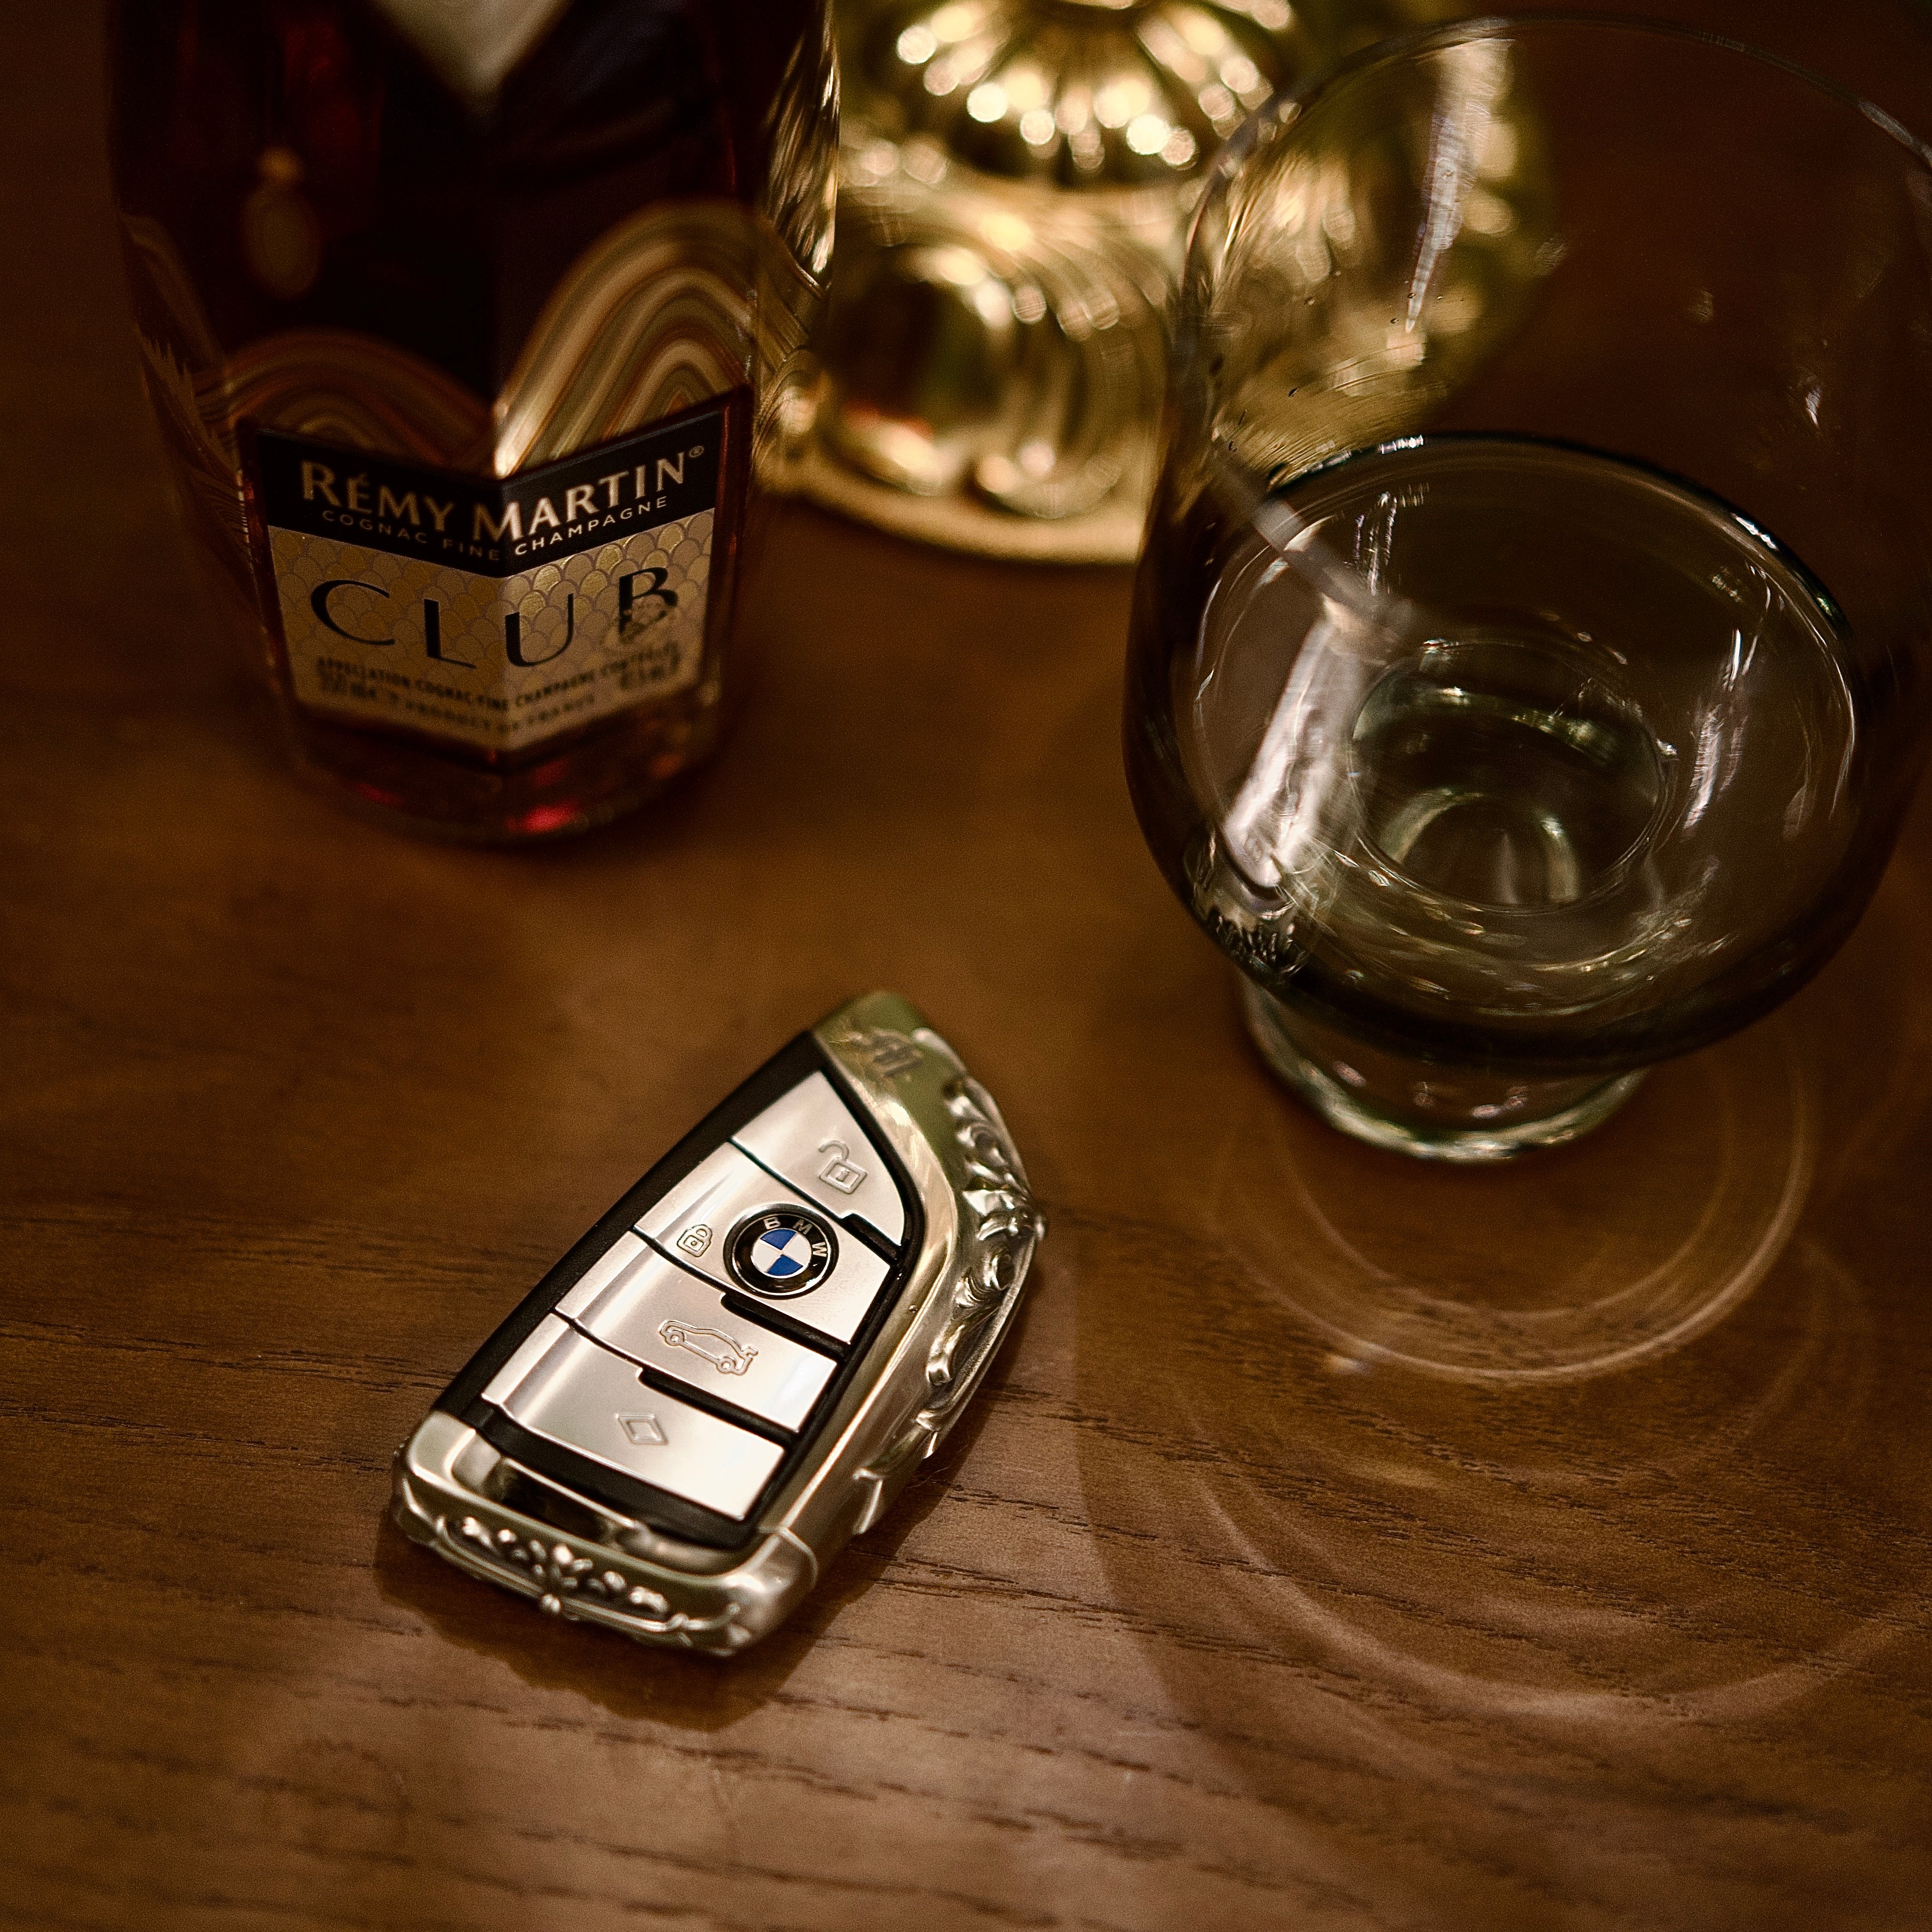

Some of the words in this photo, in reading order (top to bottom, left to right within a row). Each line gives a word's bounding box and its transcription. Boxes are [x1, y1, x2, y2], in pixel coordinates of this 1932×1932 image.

[301, 460, 456, 531] RÉMY
[322, 510, 427, 544] COGNAC
[442, 538, 500, 561] FINE
[514, 496, 668, 556] CHAMPAGNE
[310, 567, 679, 669] CLUB
[763, 1216, 829, 1258] BMW
